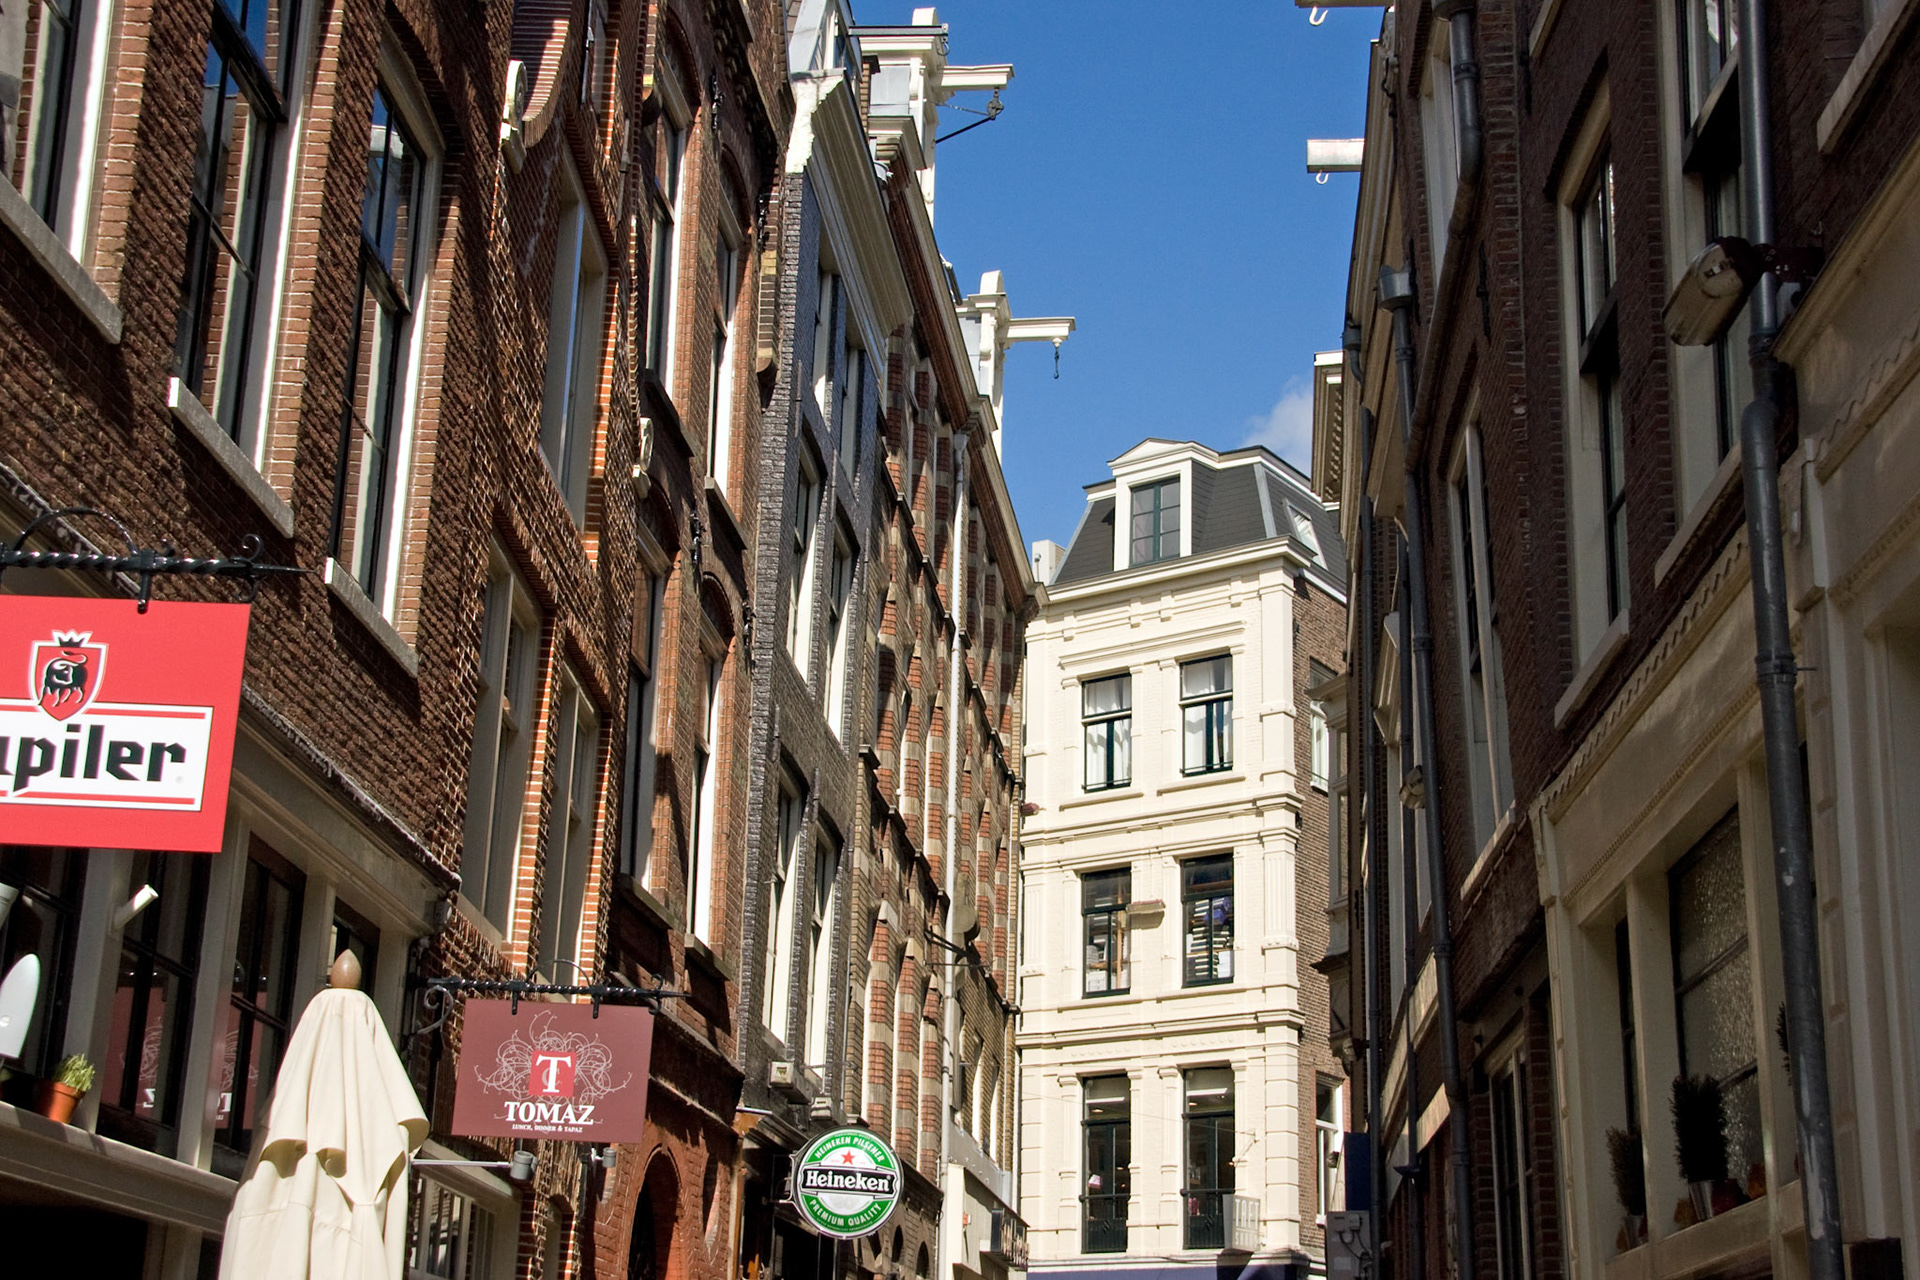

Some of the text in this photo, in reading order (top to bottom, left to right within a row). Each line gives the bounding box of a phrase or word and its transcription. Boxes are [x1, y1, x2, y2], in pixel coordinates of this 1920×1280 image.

[504, 1101, 595, 1126] TOMAZ
[534, 1124, 557, 1132] DINNER
[814, 1136, 886, 1163] HEINEKEN PILSENER
[805, 1170, 890, 1192] Heineken
[809, 1198, 845, 1227] PREMIUM
[847, 1202, 883, 1227] QUALITY
[1235, 1198, 1260, 1230] TAFT
